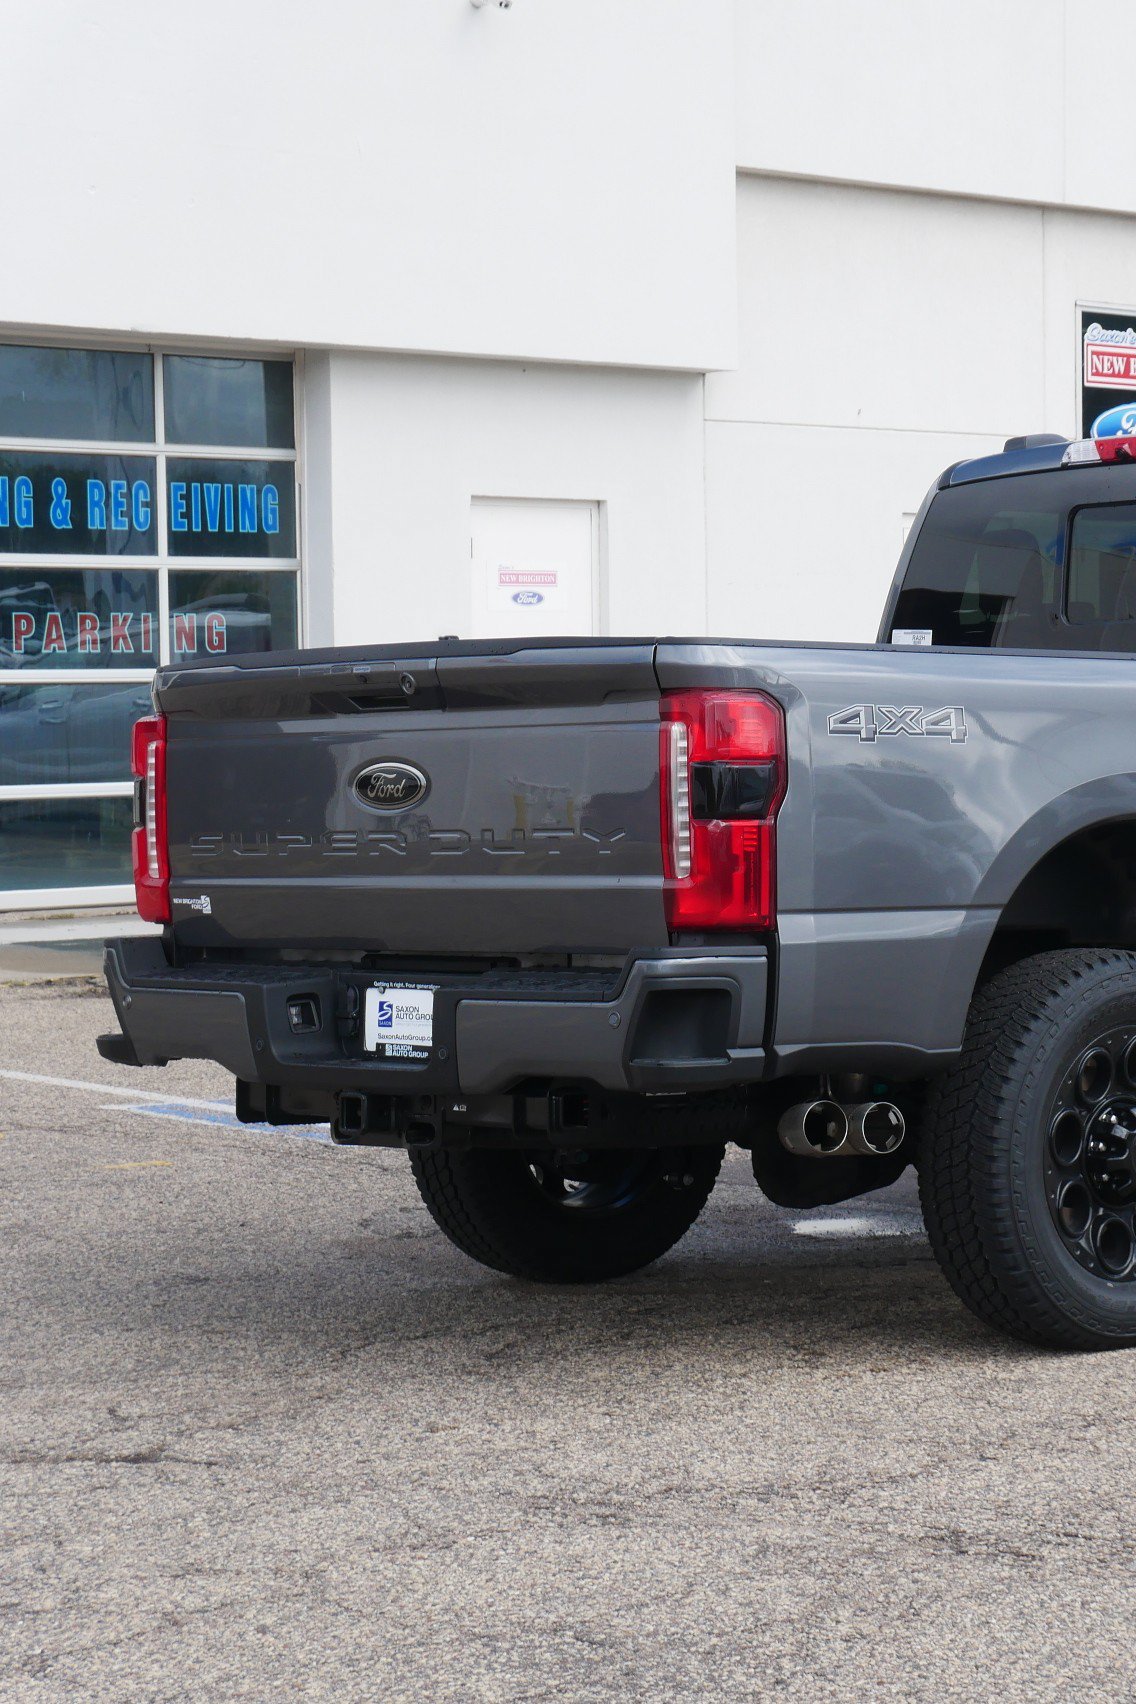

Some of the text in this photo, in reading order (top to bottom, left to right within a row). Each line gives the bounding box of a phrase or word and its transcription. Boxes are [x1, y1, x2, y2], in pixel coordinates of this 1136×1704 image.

[1091, 354, 1127, 375] NEW
[50, 477, 72, 529] &
[500, 574, 555, 583] NEW BRIGHTON
[517, 592, 539, 604] Ford
[12, 612, 227, 654] PARKING
[367, 772, 406, 798] Ford
[190, 827, 627, 856] SUPER DUTY
[395, 1005, 420, 1013] SAXON
[415, 1013, 433, 1021] GRO
